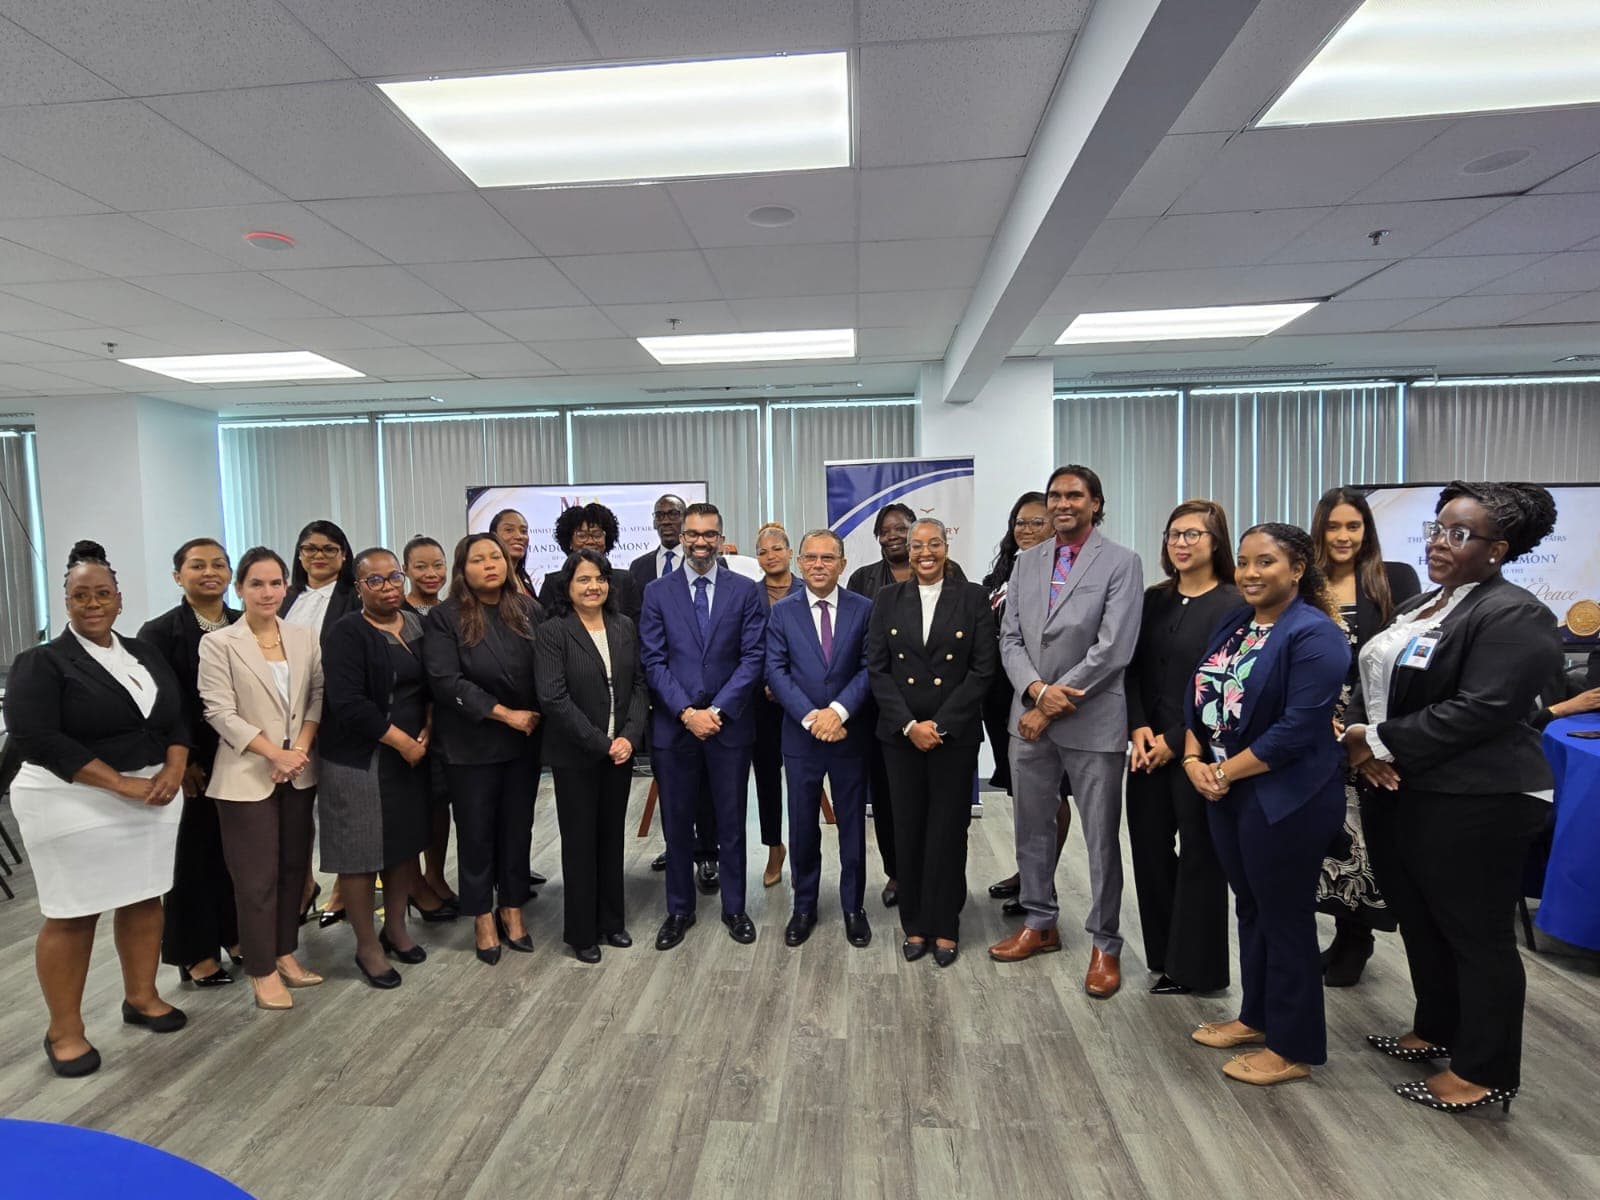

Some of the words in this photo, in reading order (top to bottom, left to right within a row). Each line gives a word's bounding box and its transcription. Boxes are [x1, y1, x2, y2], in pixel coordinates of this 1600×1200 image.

[630, 525, 652, 533] AFFAIR
[1544, 535, 1568, 543] FAIRS
[617, 542, 650, 551] MONY
[1518, 553, 1559, 564] MONY
